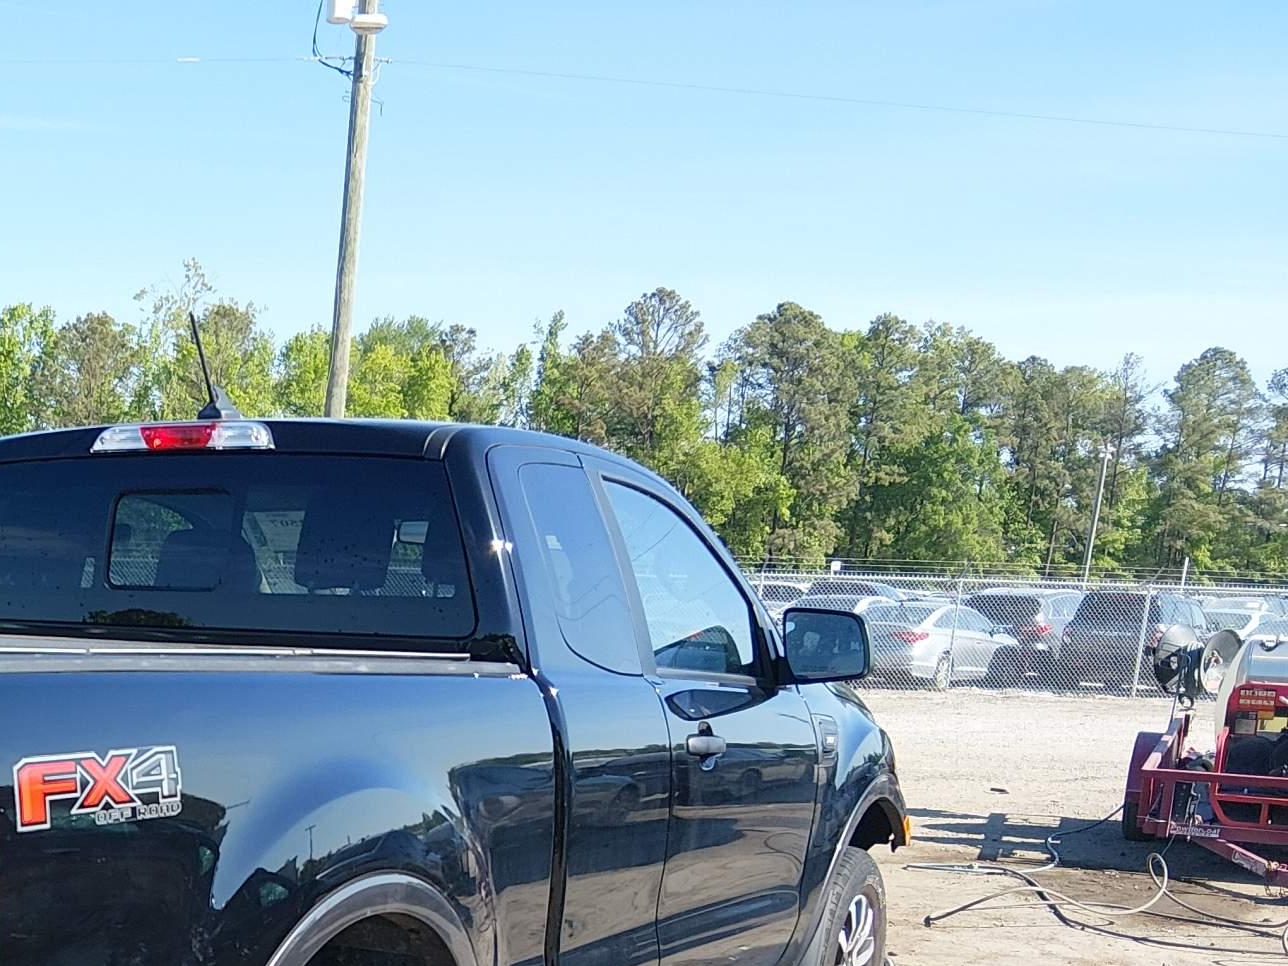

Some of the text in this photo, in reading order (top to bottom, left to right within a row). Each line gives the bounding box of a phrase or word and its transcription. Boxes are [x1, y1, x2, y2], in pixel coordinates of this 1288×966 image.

[13, 745, 182, 832] FX4
[95, 801, 183, 826] OFF ROAD
